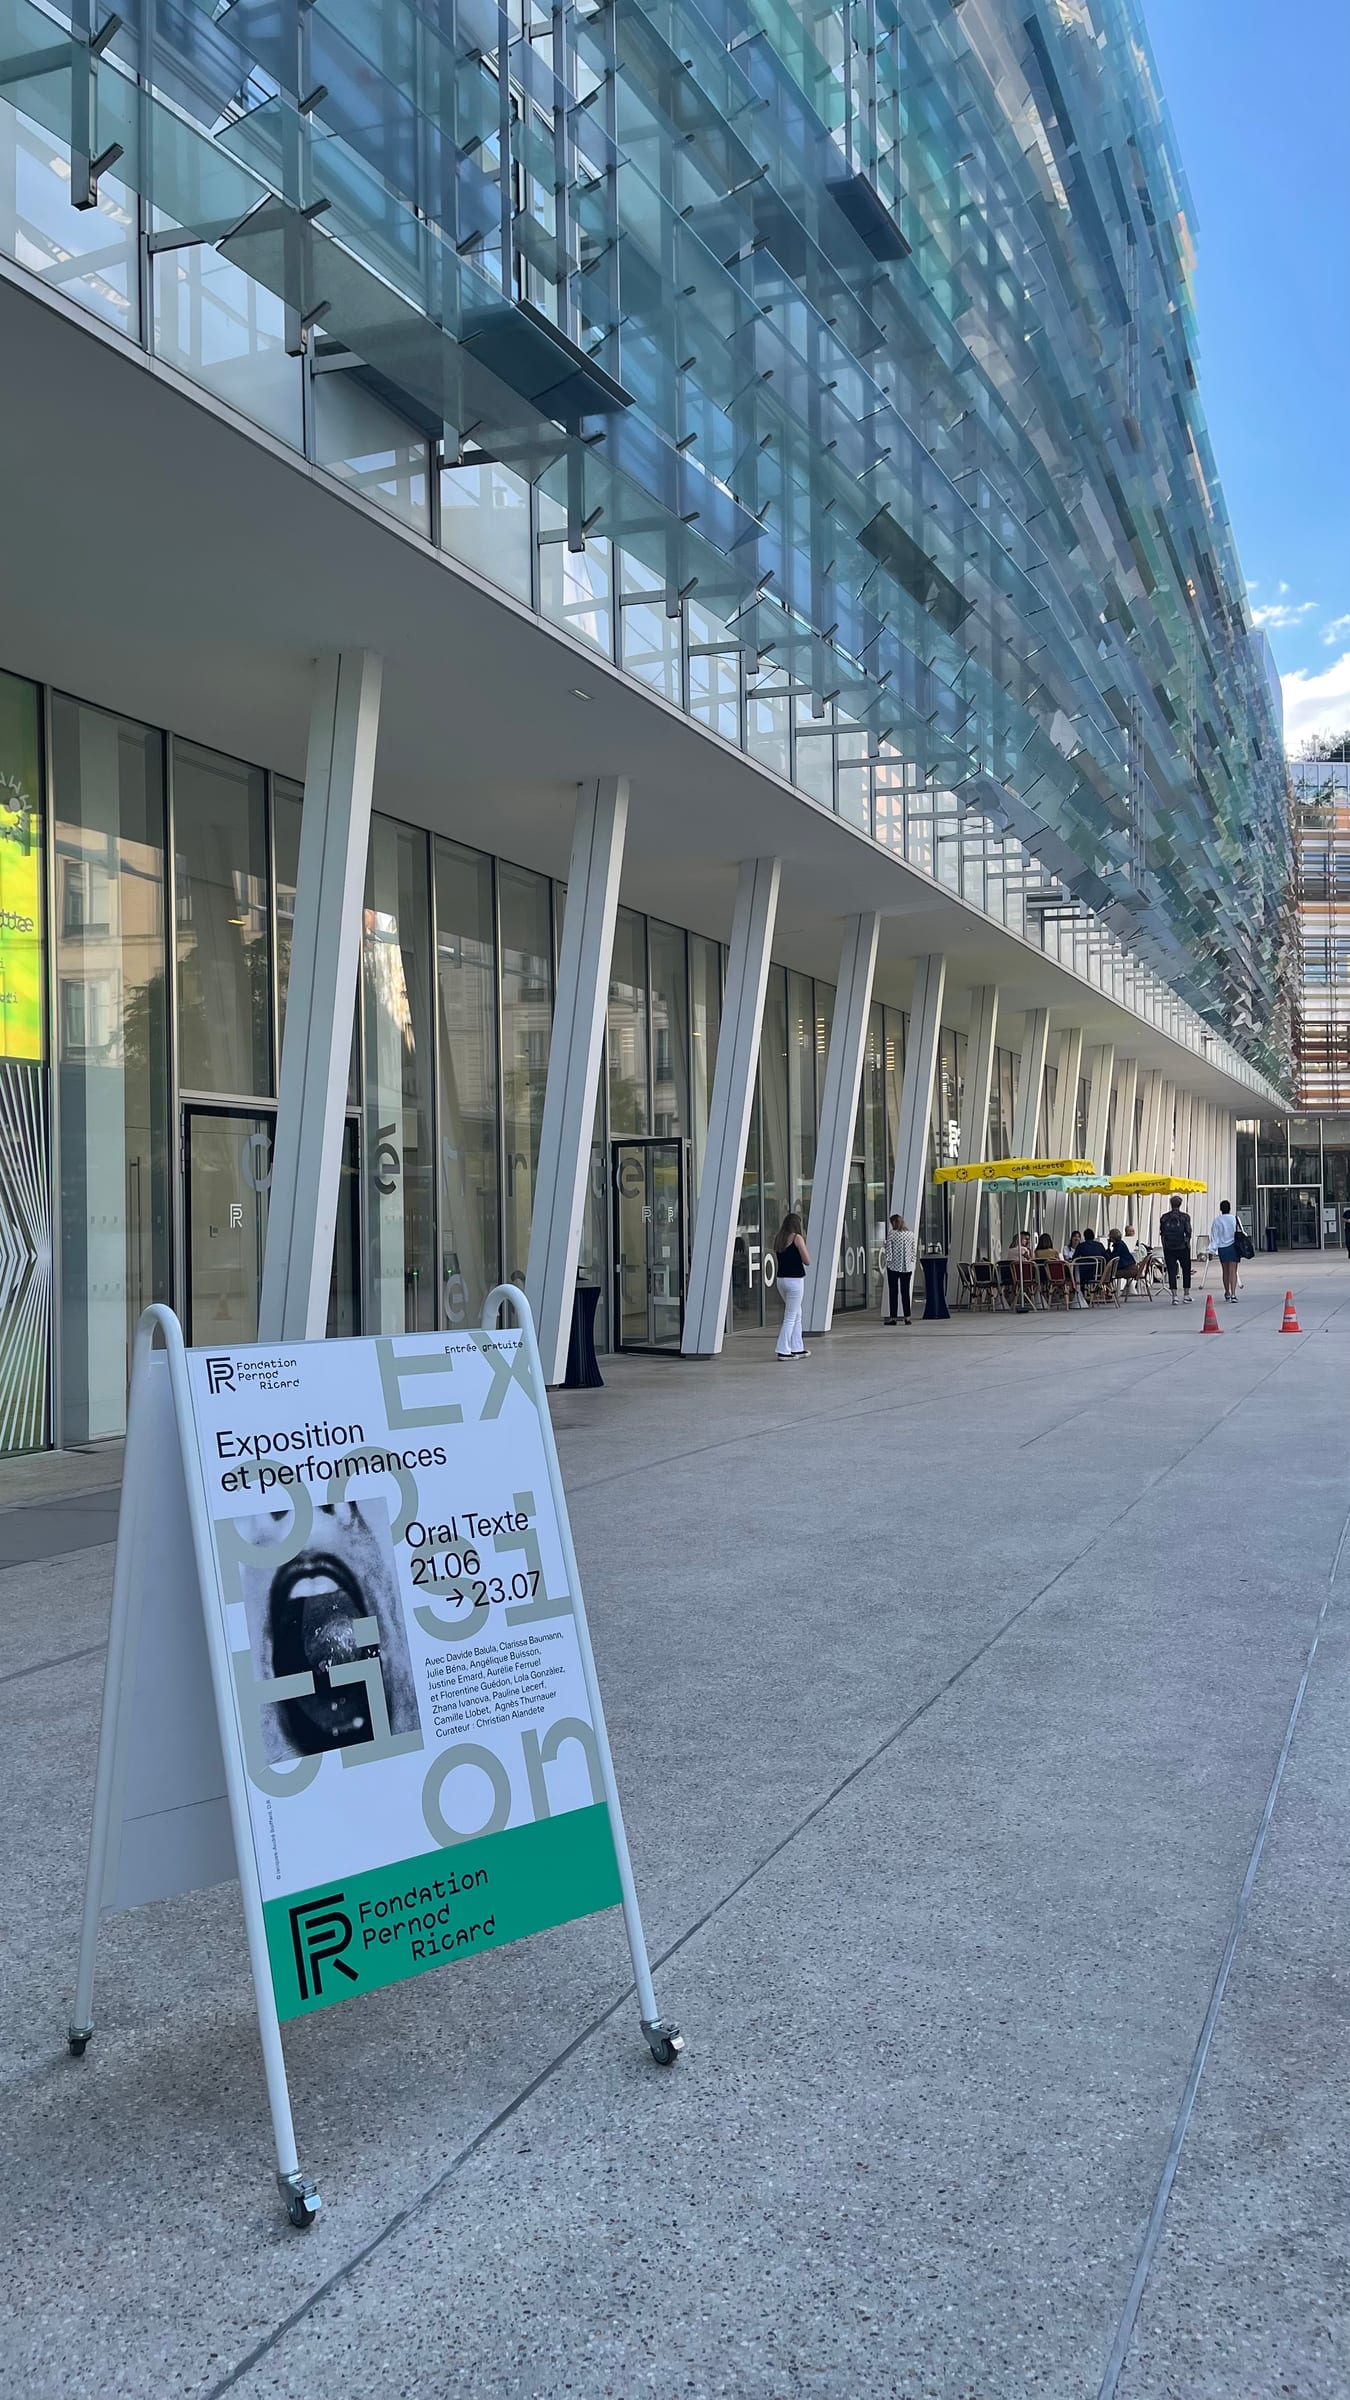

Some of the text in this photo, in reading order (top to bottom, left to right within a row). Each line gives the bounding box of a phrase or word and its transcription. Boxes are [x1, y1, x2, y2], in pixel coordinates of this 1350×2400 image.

[237, 1358, 297, 1371] Fondation
[445, 1340, 523, 1354] Entrée gratuite
[238, 1370, 279, 1382] Pernod
[260, 1379, 300, 1390] Ricard
[216, 1421, 365, 1460] Exposition
[221, 1446, 447, 1494] et performances
[405, 1511, 529, 1548] Oral Texte
[410, 1550, 480, 1585] 21.06
[472, 1570, 540, 1607] 23.07
[425, 1632, 564, 1667] Avec Davide Balula, Clarissa Baumann,
[427, 1647, 541, 1679] Julie Béna, Angélique Buisson,
[428, 1658, 541, 1690] Justine Emard, Aurélie Ferruel
[430, 1694, 439, 1702] et
[440, 1686, 479, 1700] Florentine
[480, 1678, 512, 1690] Guédon,
[513, 1674, 529, 1683] Lola
[432, 1703, 457, 1715] Zhana
[459, 1695, 491, 1707] Ivanova,
[492, 1688, 520, 1700] Pauline
[434, 1691, 557, 1726] Camille Llobet, Agnès Thurnauer
[435, 1724, 470, 1738] Curateur
[476, 1715, 511, 1728] Christian
[511, 1705, 545, 1719] Alandete
[359, 1869, 489, 1923] Fondation
[363, 1903, 450, 1950] Pernod
[411, 1915, 496, 1961] Ricard
